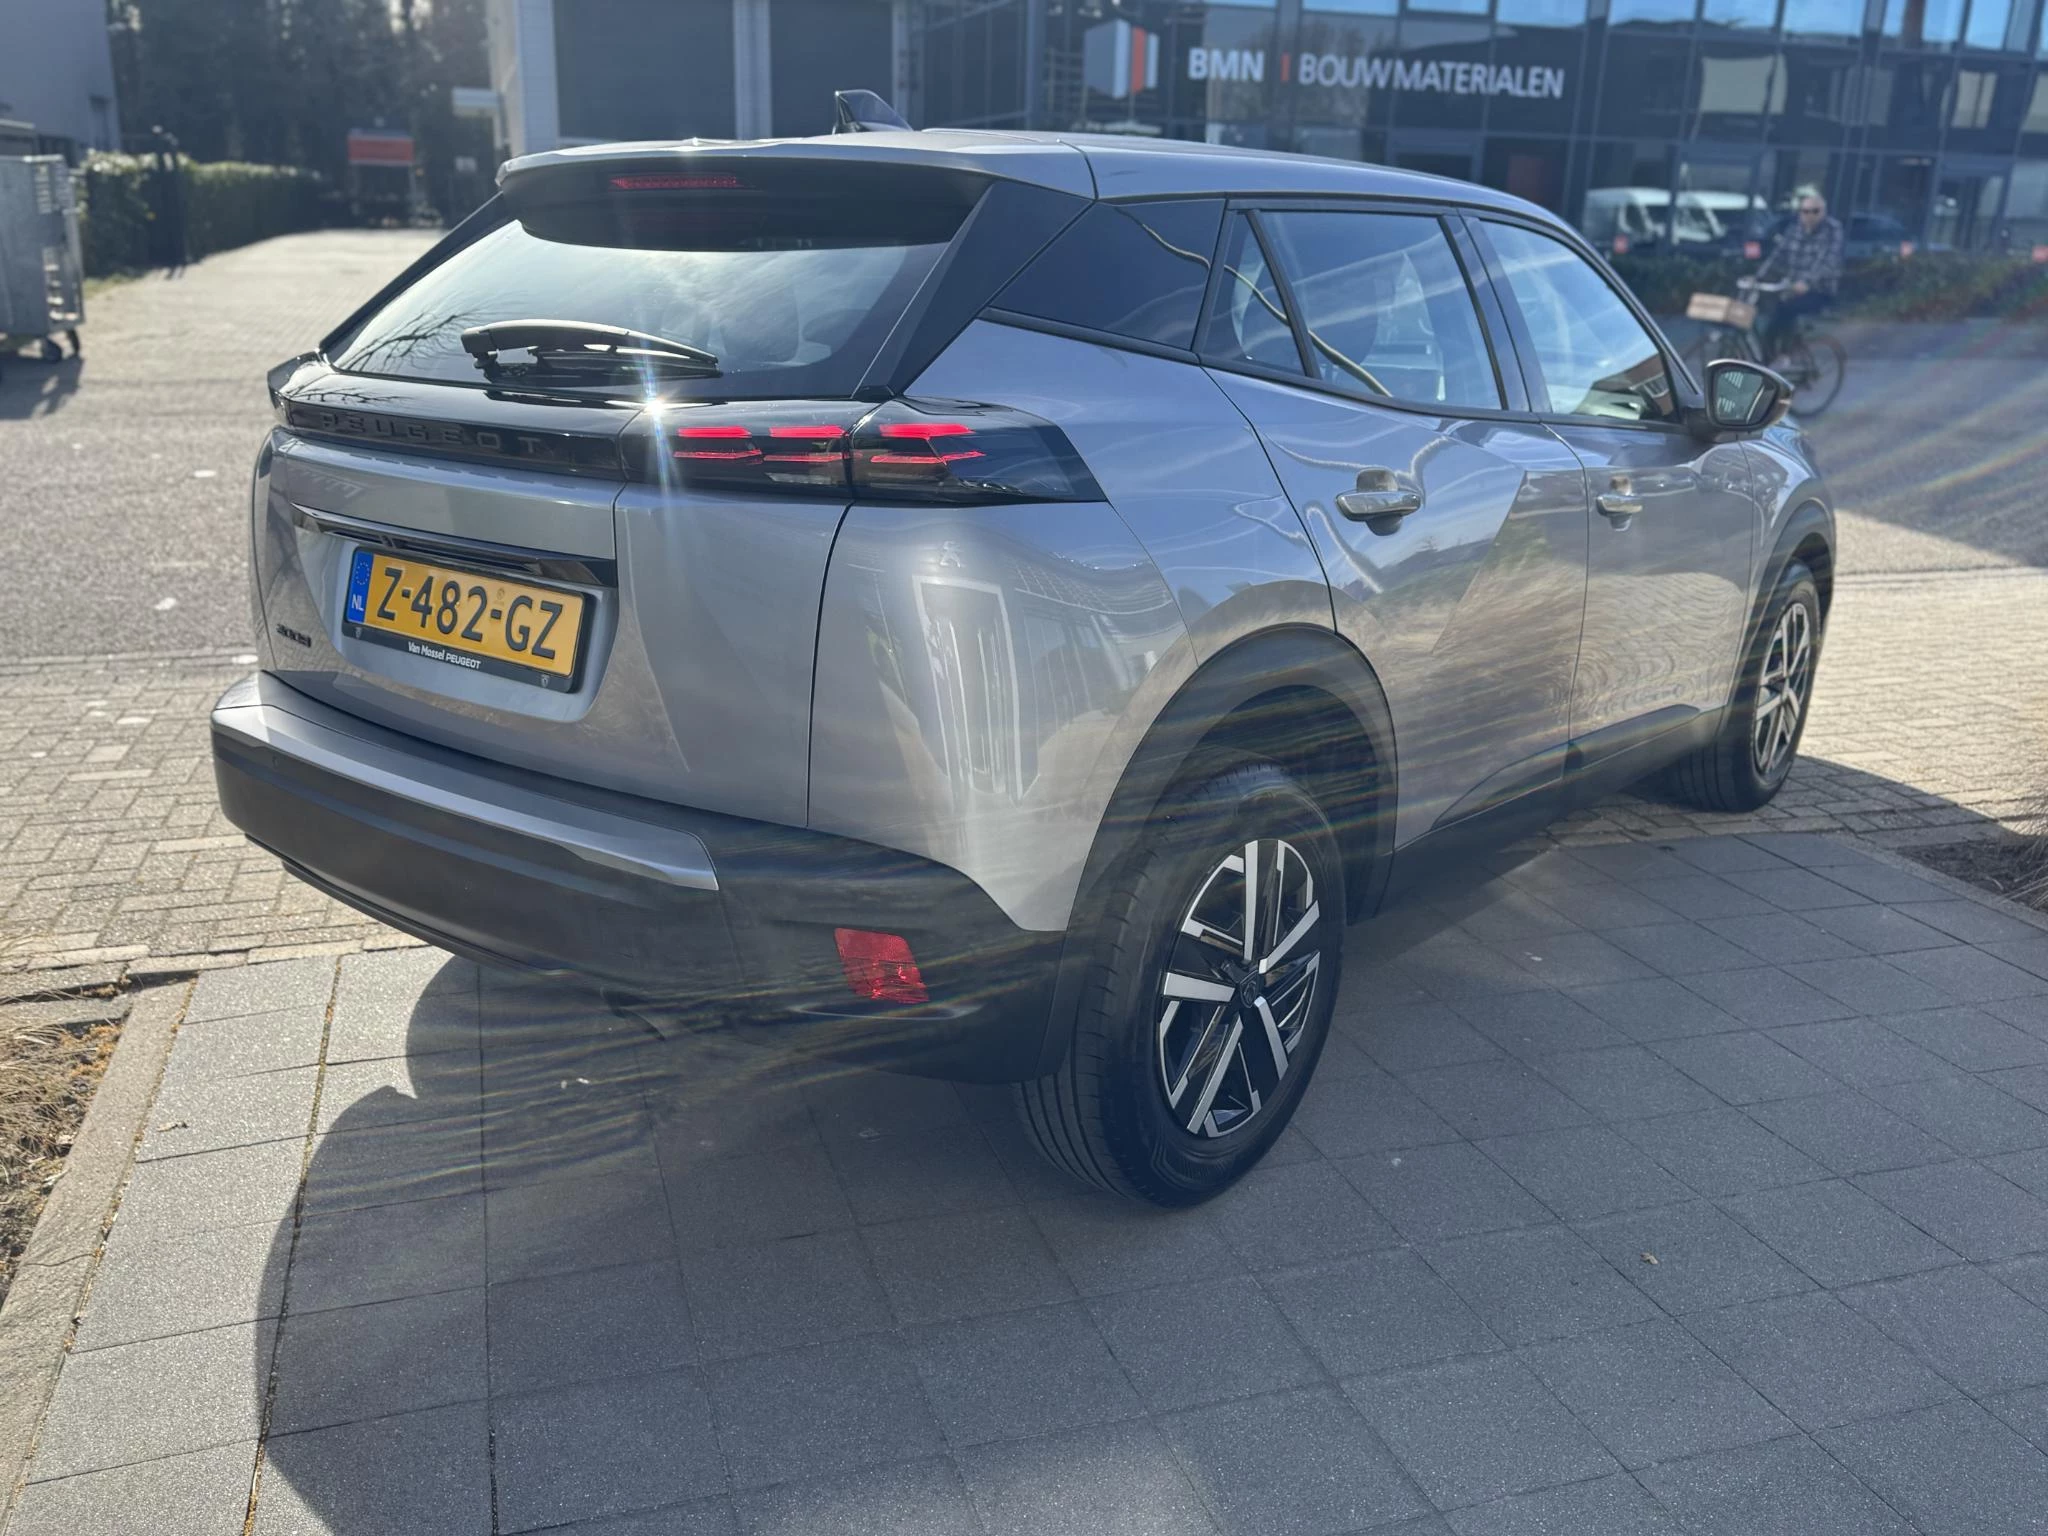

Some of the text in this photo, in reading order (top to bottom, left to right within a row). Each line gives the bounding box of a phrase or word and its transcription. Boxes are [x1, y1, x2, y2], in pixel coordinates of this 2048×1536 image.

[1187, 47, 1565, 99] BMN BOUWMATERIALEN
[318, 410, 542, 454] PEUGEOT
[351, 594, 365, 612] NL
[377, 566, 563, 660] Z-482-GZ
[407, 641, 421, 654] Van
[445, 652, 482, 669] PEUGEOT
